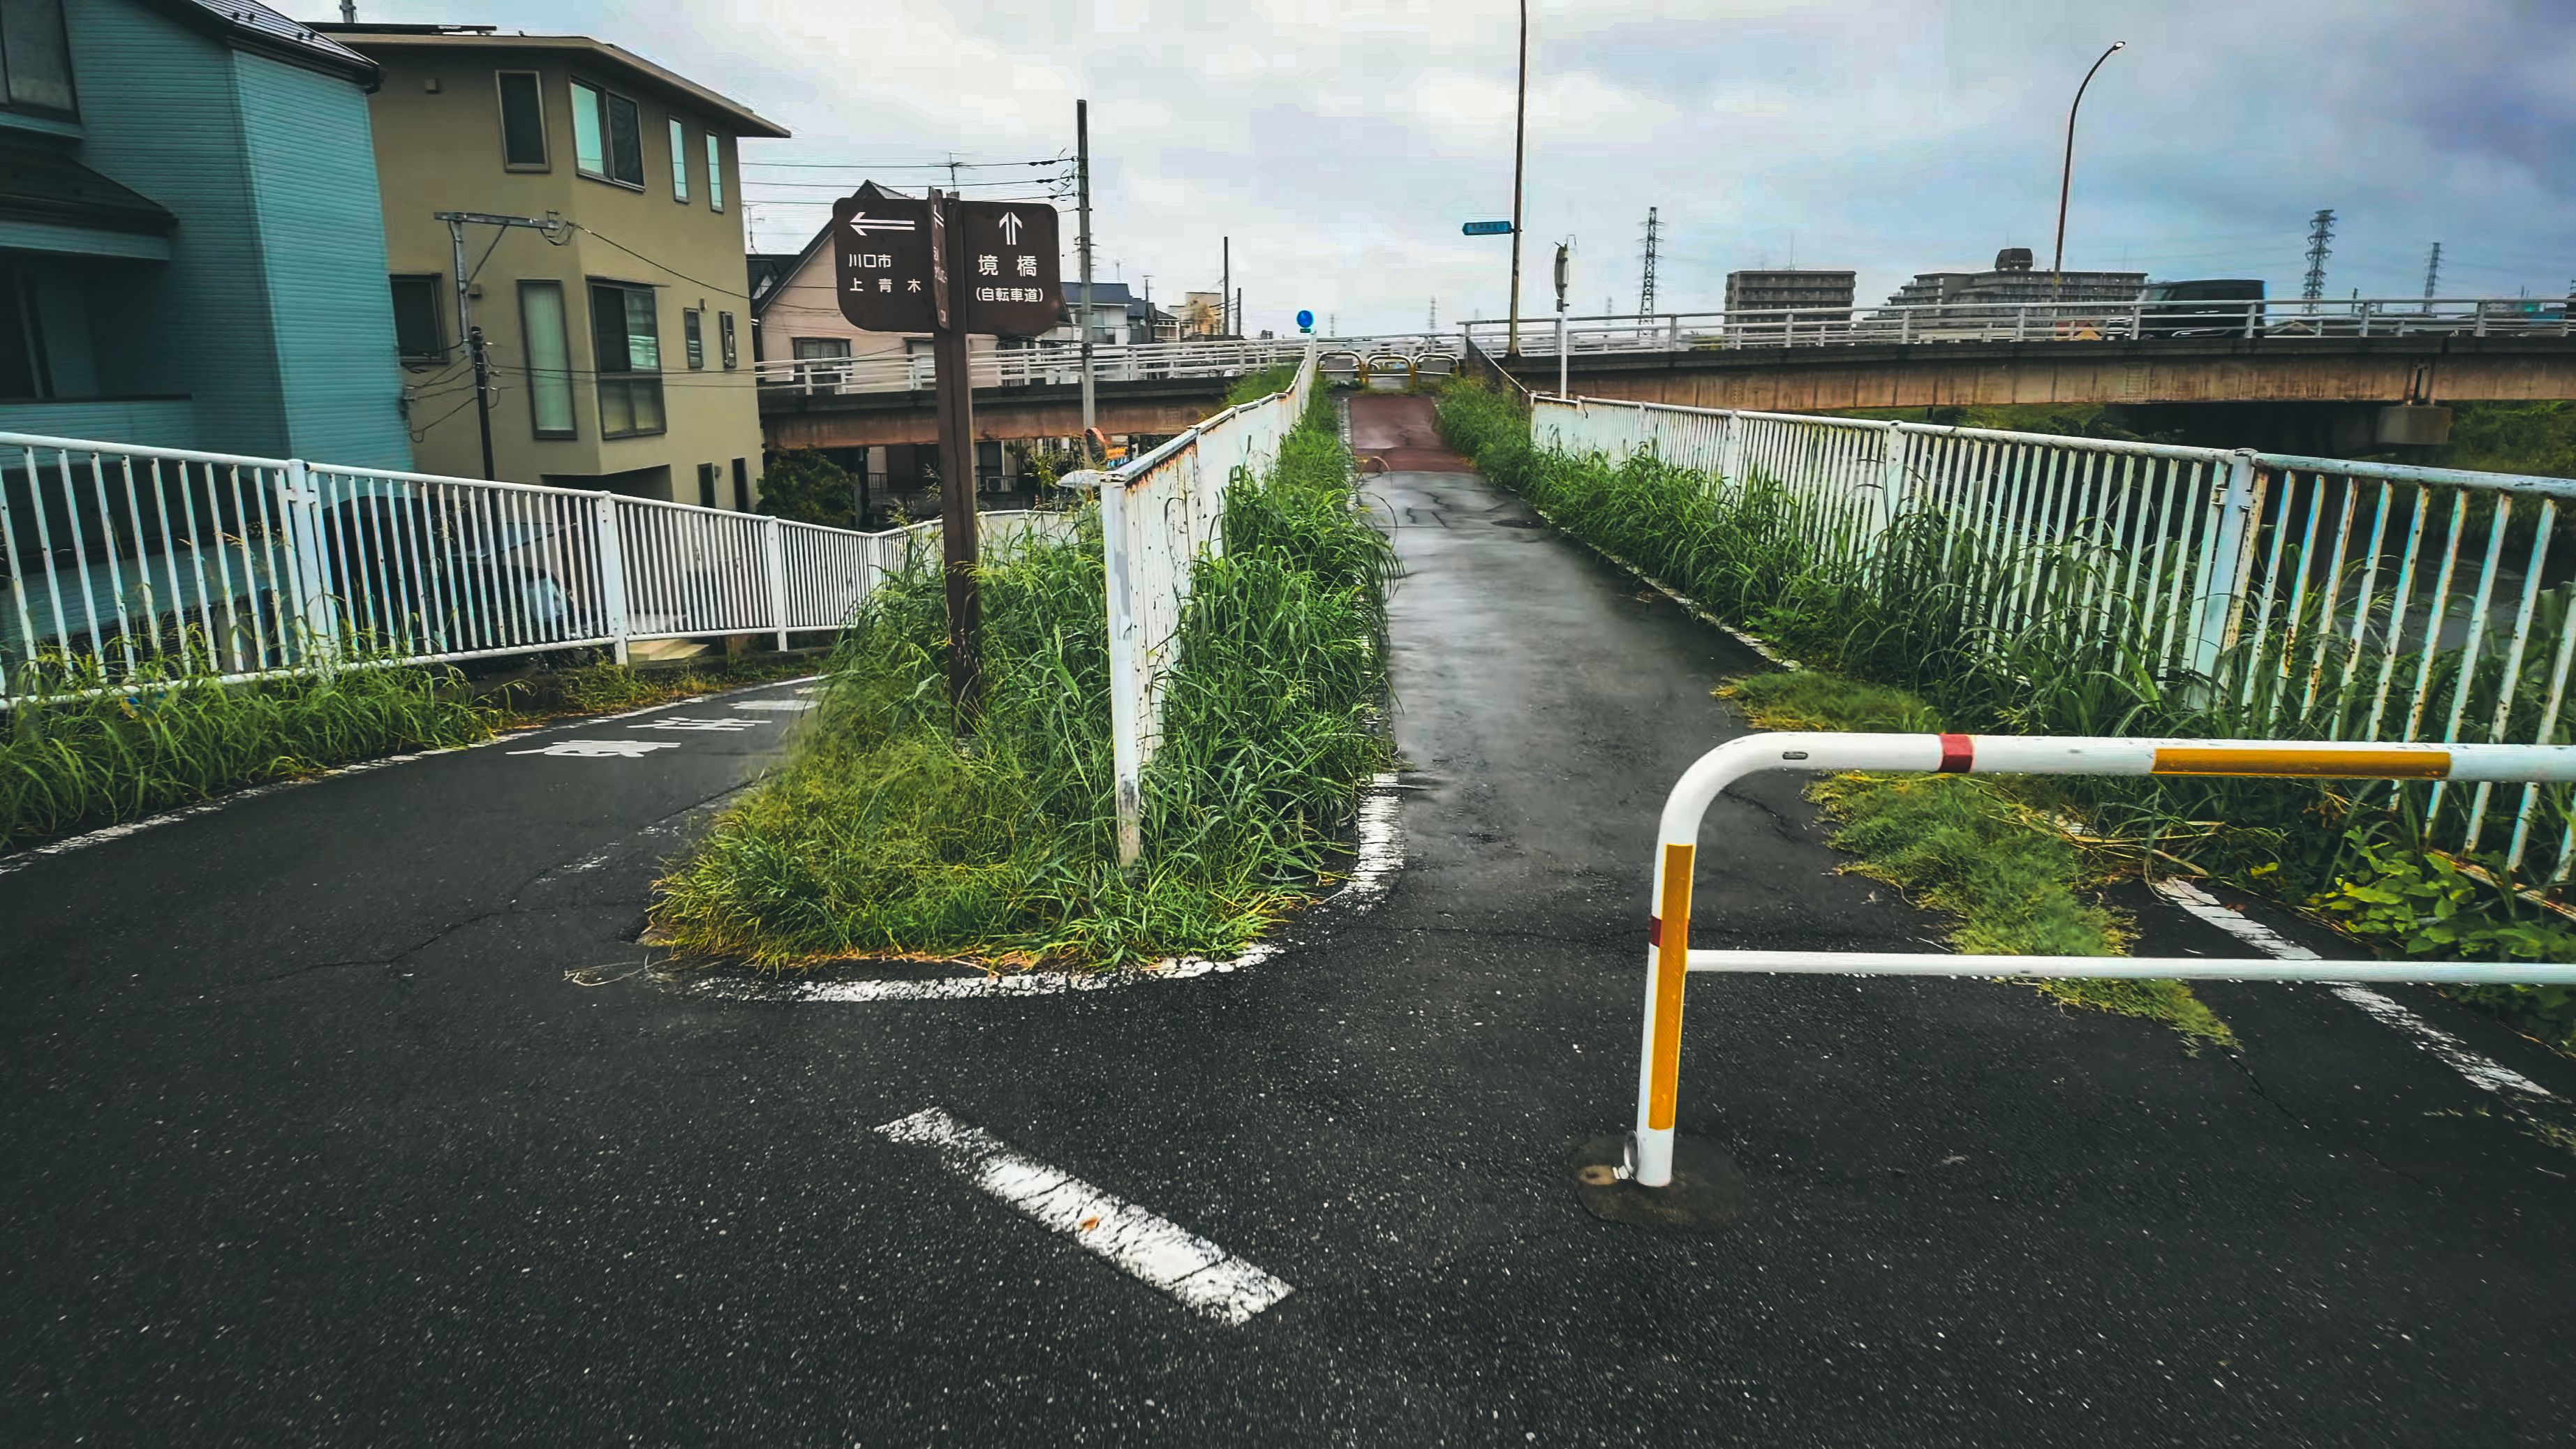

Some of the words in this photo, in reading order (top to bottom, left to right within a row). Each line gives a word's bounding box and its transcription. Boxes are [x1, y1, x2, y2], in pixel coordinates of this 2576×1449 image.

[849, 253, 891, 268] 川口市
[978, 254, 1037, 277] 境橋
[850, 277, 921, 293] 上青木
[976, 287, 1043, 303] (自転車道)
